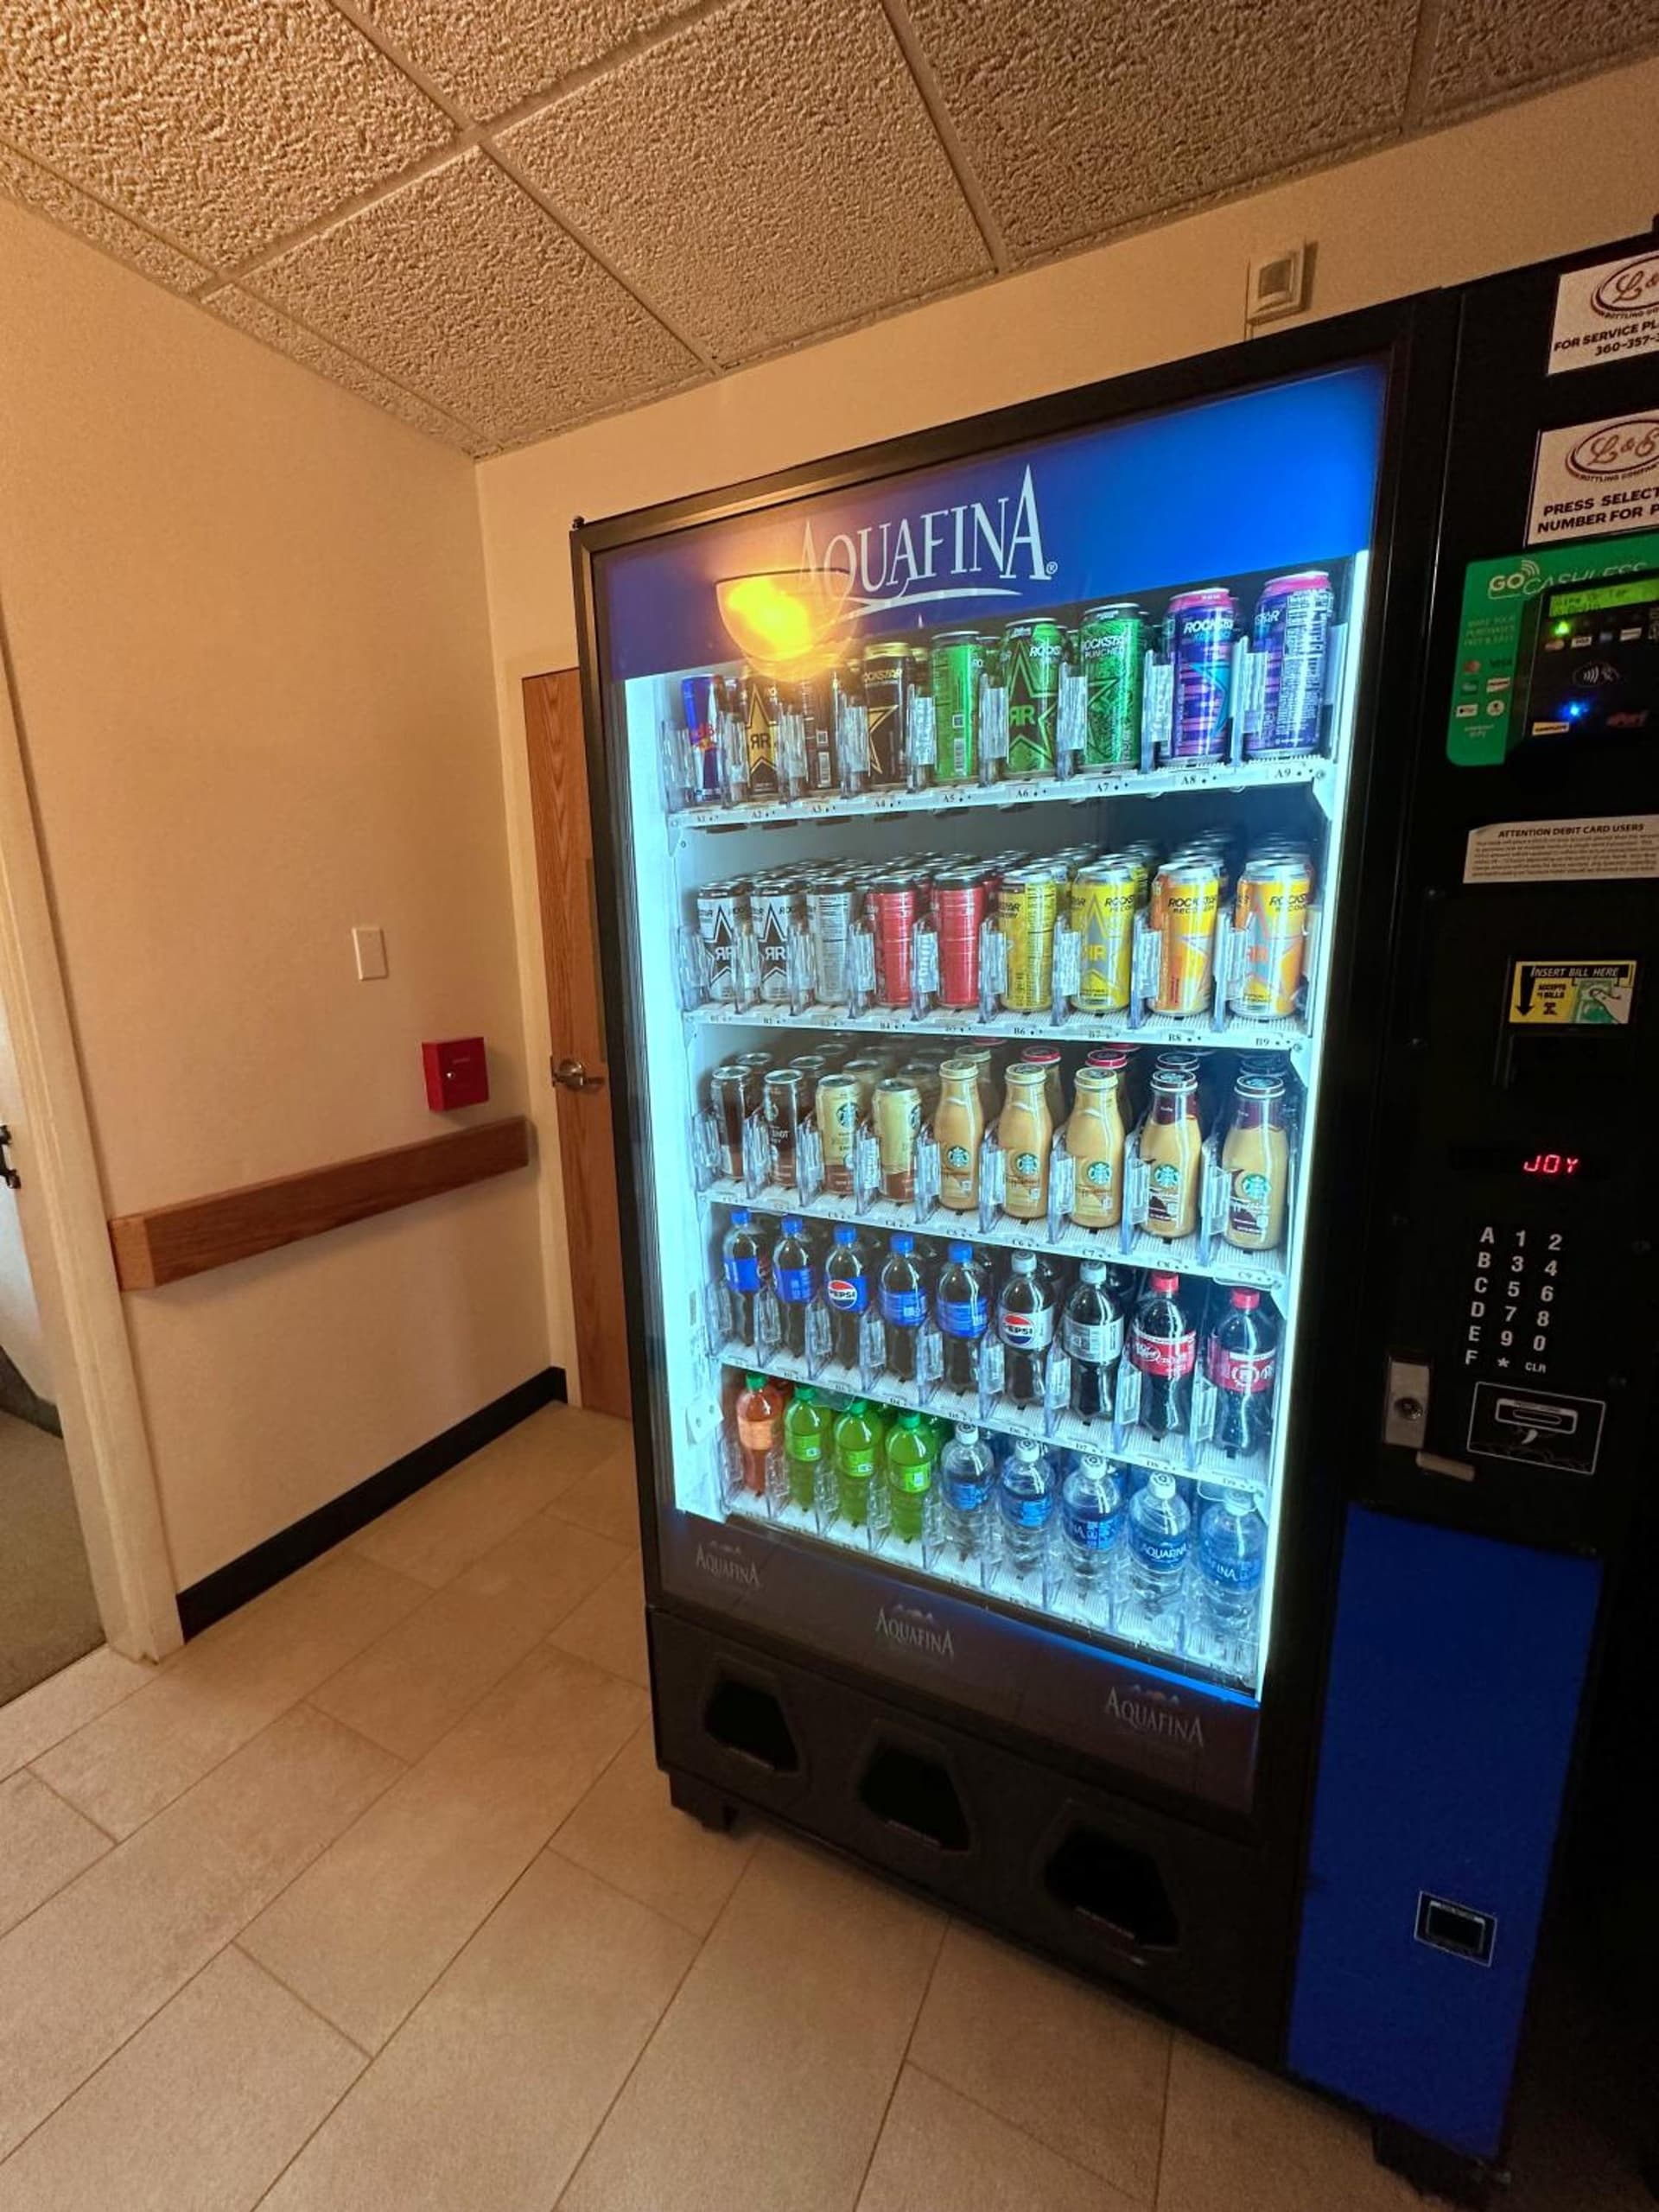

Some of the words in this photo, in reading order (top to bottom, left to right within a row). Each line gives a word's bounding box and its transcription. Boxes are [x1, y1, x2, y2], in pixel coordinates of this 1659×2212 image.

[1554, 338, 1580, 351] FOR
[1583, 324, 1639, 346] SERVICE
[1544, 499, 1595, 516] PRESS
[798, 463, 1052, 600] AQUAFINA
[1538, 513, 1606, 533] NUMBER
[1610, 507, 1643, 522] FOR
[1490, 574, 1524, 592] GO
[1181, 776, 1197, 786] A8
[1274, 768, 1292, 778] A9
[1016, 790, 1029, 798] A6
[1095, 782, 1109, 792] A7
[1498, 827, 1550, 838] ATTENTION
[1553, 826, 1581, 836] DEBIT
[1583, 824, 1611, 835] CARD
[1613, 823, 1645, 833] USERS
[1530, 966, 1567, 977] INSERT
[1568, 967, 1589, 977] BILL
[1592, 967, 1619, 976] HERE
[1523, 1154, 1579, 1173] JOY
[1480, 1227, 1494, 1243] A
[1516, 1230, 1525, 1247] 1
[1548, 1234, 1562, 1250] 2
[1478, 1252, 1491, 1268] B
[1511, 1255, 1523, 1272] 3
[1545, 1260, 1557, 1276] 4
[1474, 1277, 1488, 1294] C
[1508, 1281, 1521, 1297] 5
[1541, 1286, 1554, 1302] 6
[1471, 1301, 1484, 1317] D
[1504, 1306, 1517, 1322] 7
[1537, 1311, 1549, 1326] 8
[1469, 1325, 1481, 1341] E
[1500, 1331, 1512, 1346] 9
[1533, 1335, 1546, 1351] 0
[1465, 1350, 1478, 1364] F
[1525, 1362, 1546, 1373] CLR
[696, 1543, 760, 1589] AQUAFINA
[876, 1605, 954, 1657] AQUAFINA
[1104, 1687, 1204, 1747] AQUAFINA
